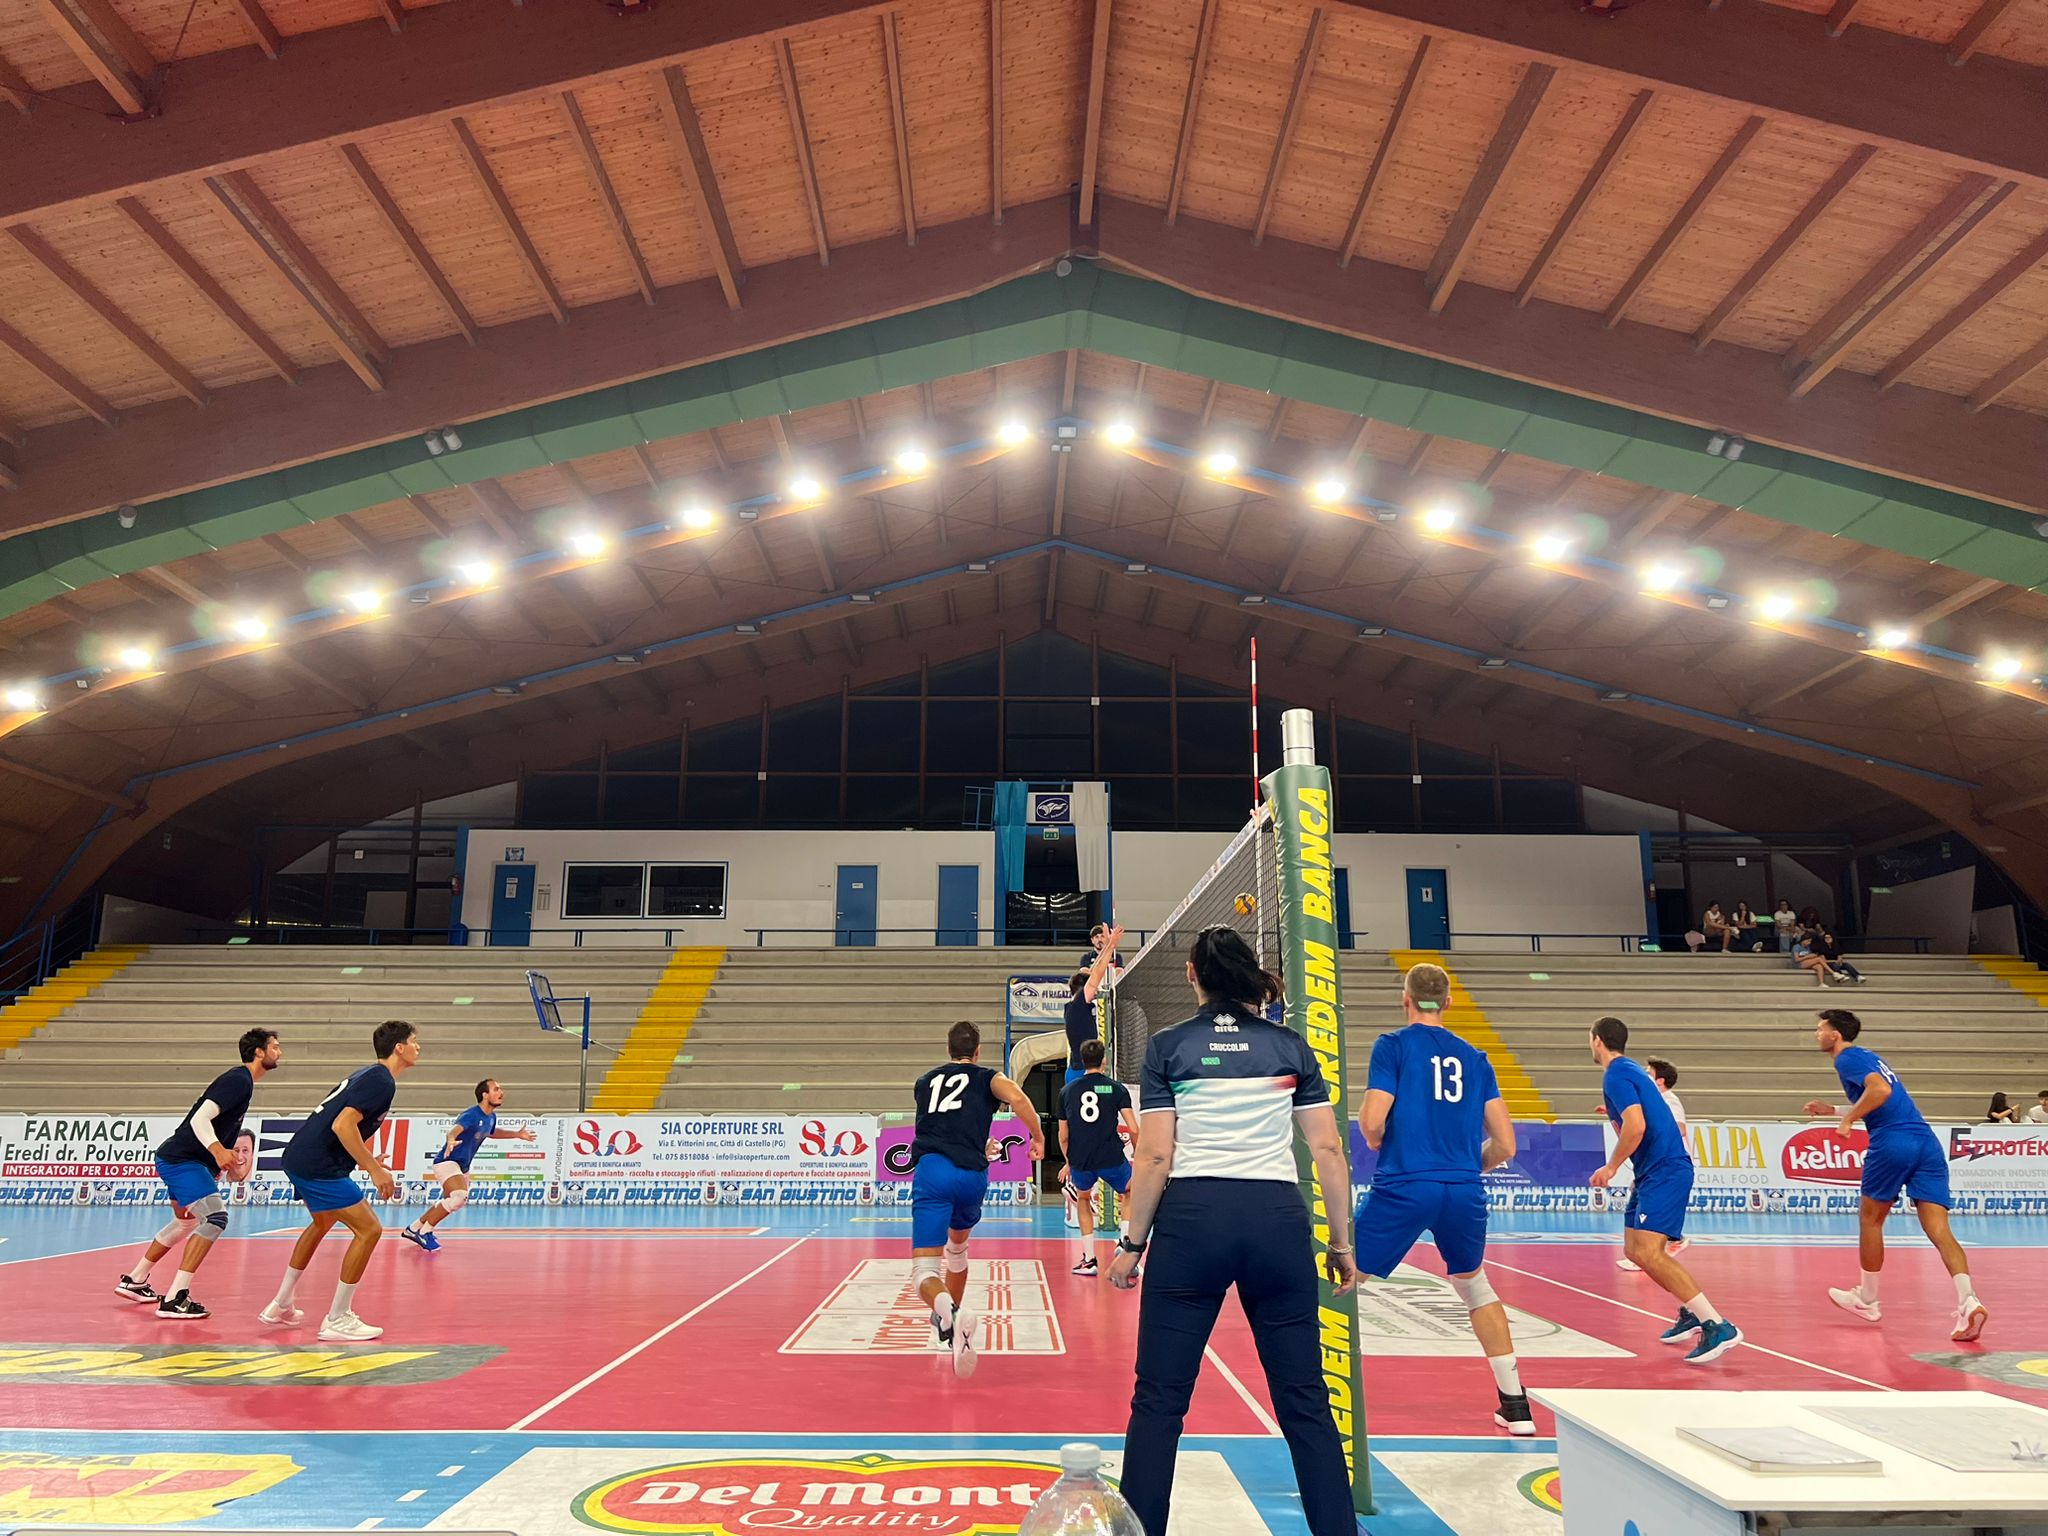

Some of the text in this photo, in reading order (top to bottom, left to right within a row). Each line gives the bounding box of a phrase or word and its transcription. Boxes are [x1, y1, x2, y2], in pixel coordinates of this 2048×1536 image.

[1298, 788, 1332, 924] BANCA
[1431, 1055, 1463, 1103] 13
[927, 1073, 970, 1113] 12
[1080, 1090, 1099, 1123] 8
[24, 1120, 149, 1141] FARMACIA
[660, 1122, 785, 1135] SIA COPERTURE SRL
[720, 1139, 735, 1147] Città
[772, 1140, 786, 1148] (PG)
[1692, 1126, 1767, 1168] ALPA
[4, 1143, 157, 1162] Eredi dr. Polverin
[716, 1153, 790, 1162] info@siacoperture.com
[5, 1165, 157, 1177] INTEGRATORI PER LO SPORT
[661, 1170, 695, 1179] stoccaggio
[773, 1170, 805, 1178] coperture
[836, 1170, 871, 1178] capannoni
[1697, 1174, 1769, 1185] CIAL FOOD
[1963, 1181, 2003, 1189] IMPIANTI
[114, 1188, 150, 1201] SAN
[270, 1188, 295, 1201] SA
[468, 1187, 546, 1200] GIUSTINO
[584, 1187, 701, 1201] SAN GIUSTINO
[740, 1188, 858, 1201] SAN GIUSTINO
[1513, 1193, 1590, 1207] GIUSTINO
[1688, 1195, 1747, 1208] USTINO
[1787, 1195, 1860, 1208] SAN GIUS
[1984, 1197, 2048, 1209] GIUSTIN
[631, 1481, 1042, 1507] Del Mont
[738, 1508, 960, 1531] Quality
